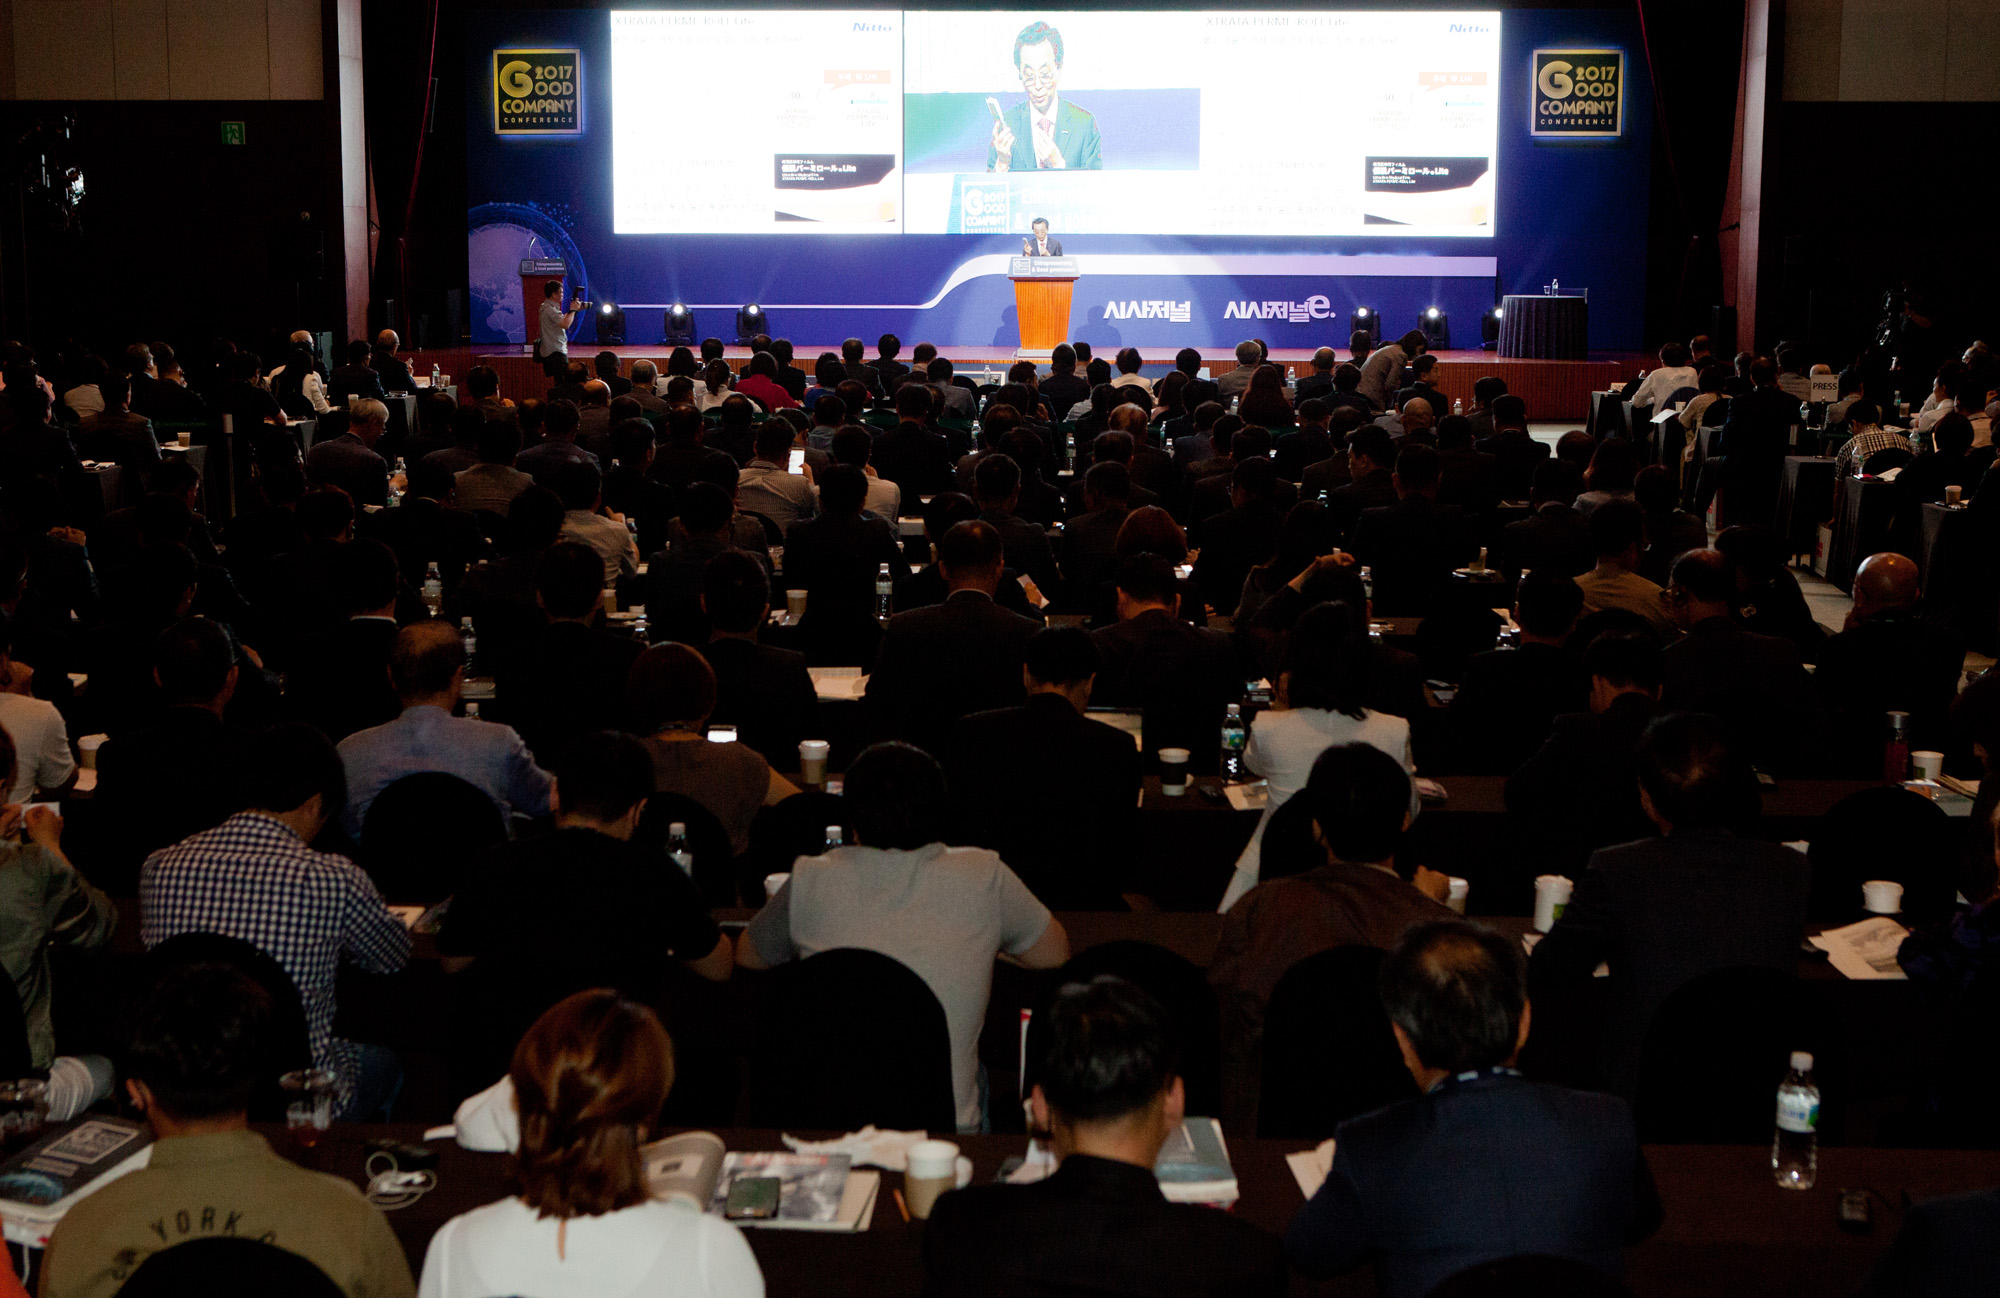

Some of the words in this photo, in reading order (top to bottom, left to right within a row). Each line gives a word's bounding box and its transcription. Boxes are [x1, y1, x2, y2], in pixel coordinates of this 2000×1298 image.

[852, 22, 892, 32] Nitto
[534, 65, 573, 80] 2017
[1575, 66, 1616, 81] 2017
[502, 99, 575, 114] COMPANY
[1540, 100, 1616, 116] COMPANY
[1540, 118, 1613, 126] CONFERENCE
[1103, 300, 1191, 323] 시사저널
[149, 1206, 243, 1242] YORK
